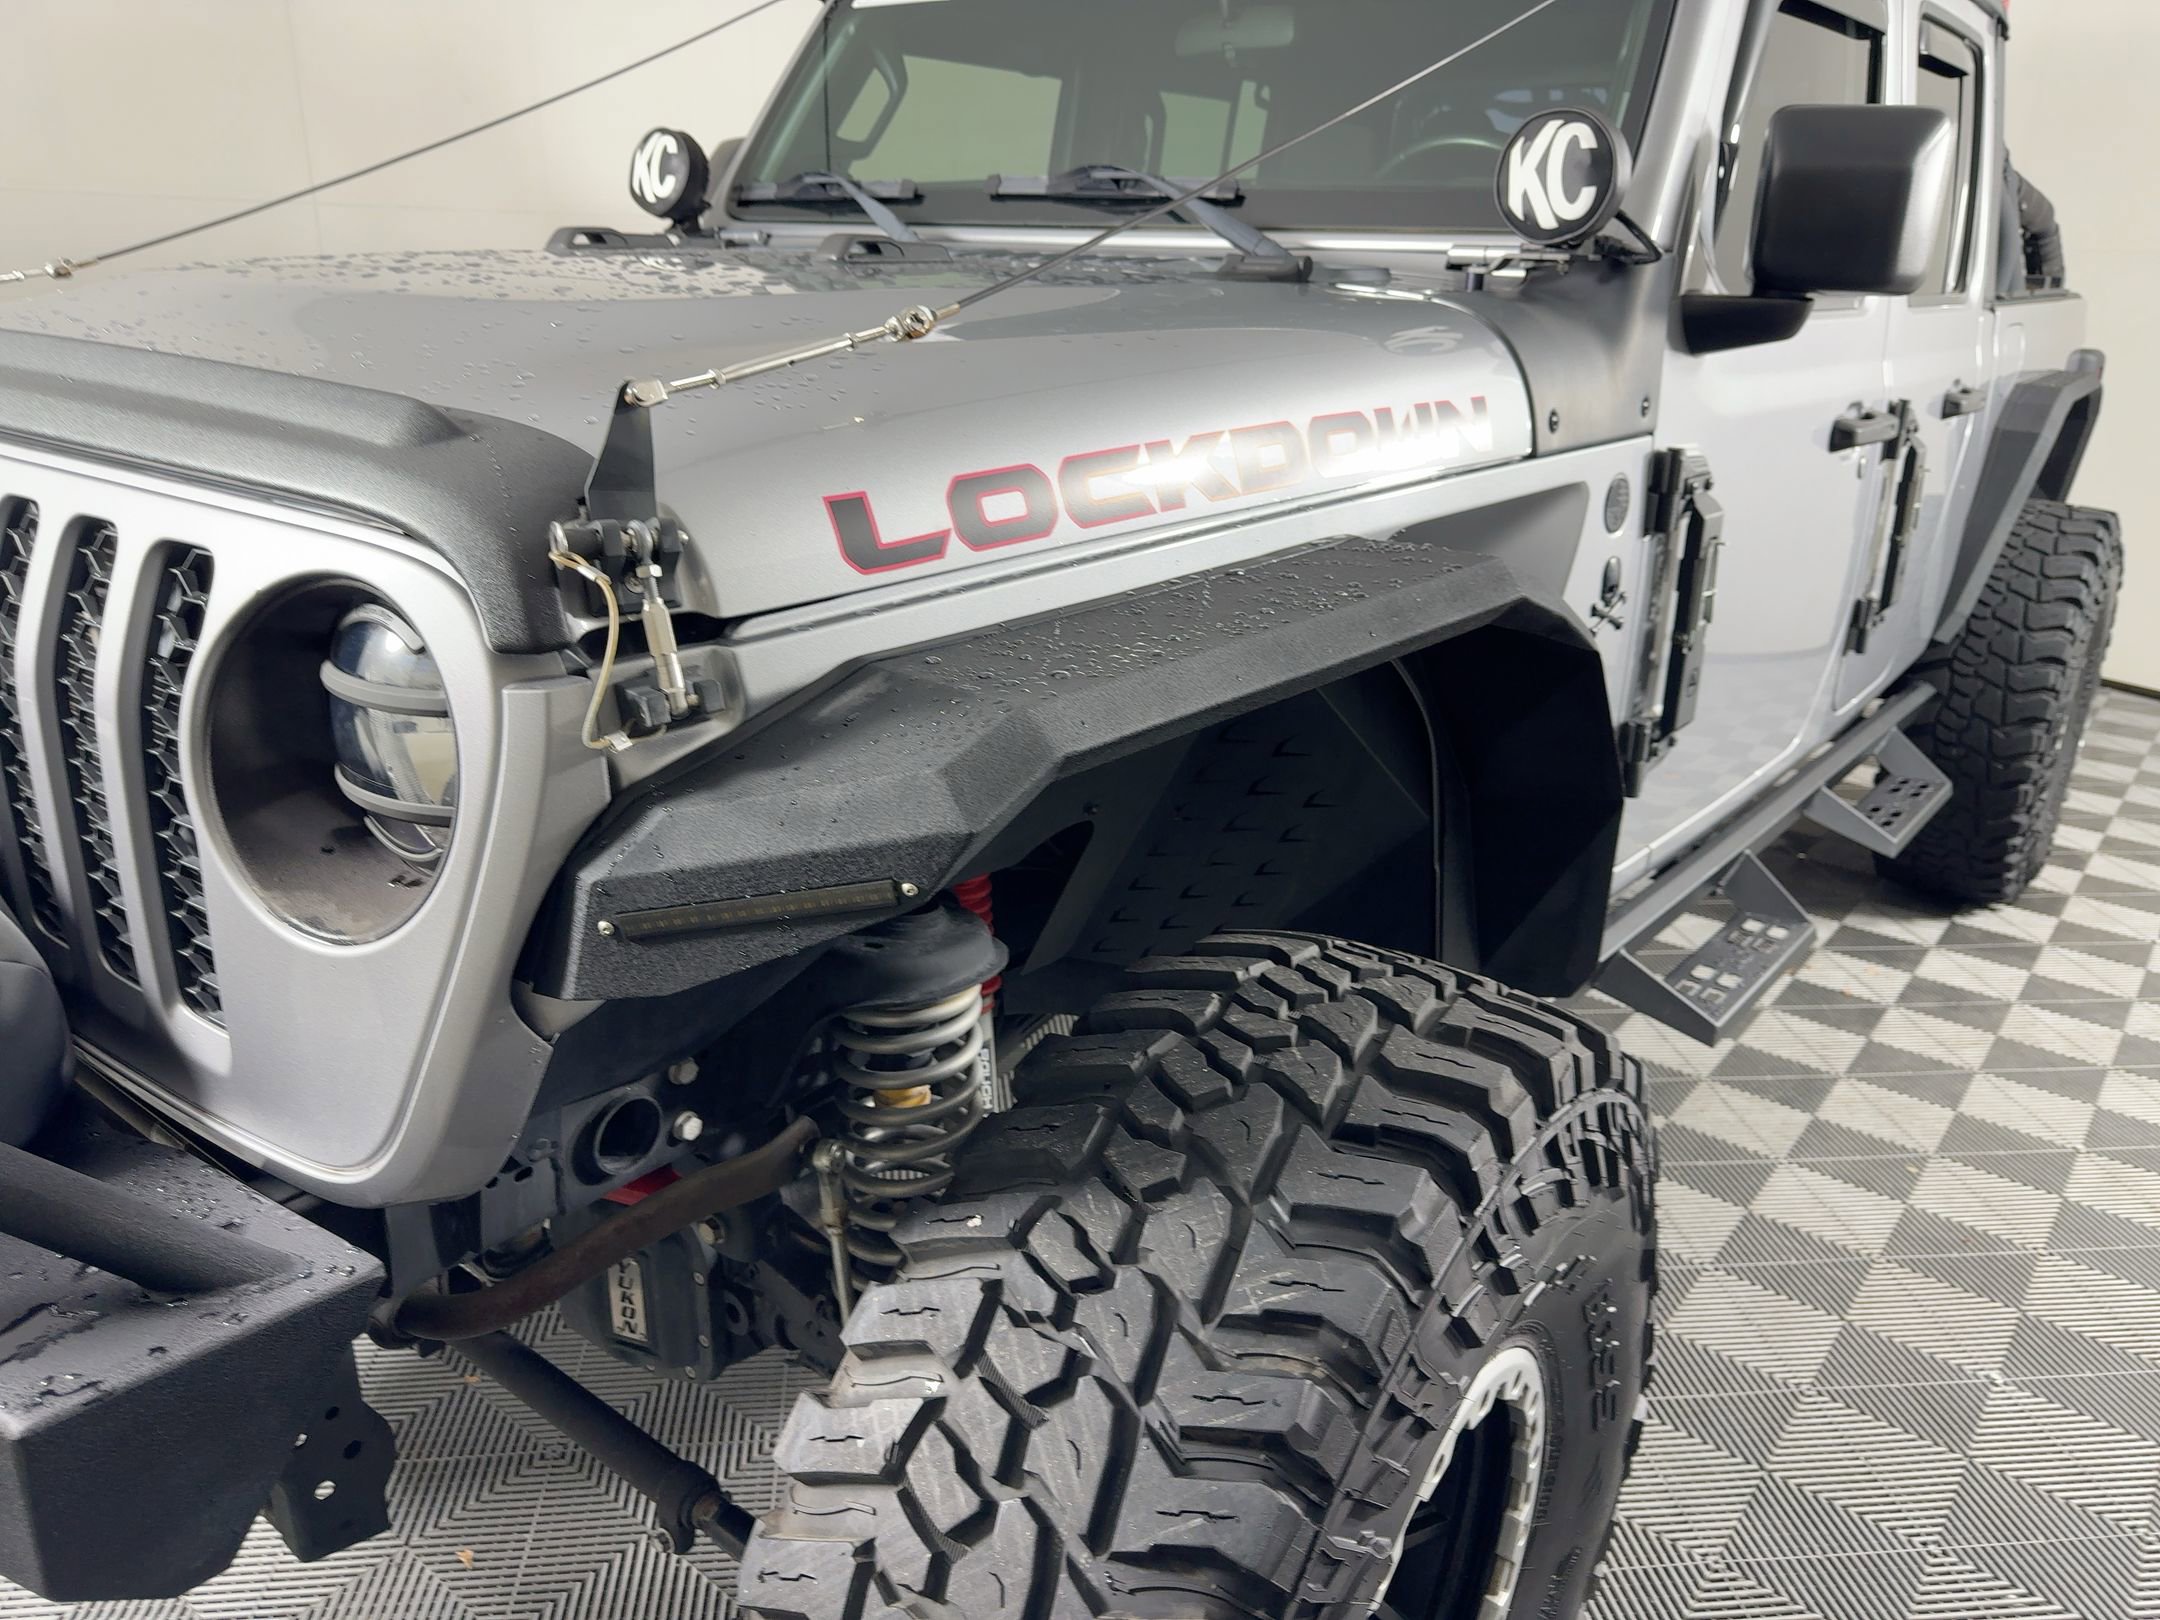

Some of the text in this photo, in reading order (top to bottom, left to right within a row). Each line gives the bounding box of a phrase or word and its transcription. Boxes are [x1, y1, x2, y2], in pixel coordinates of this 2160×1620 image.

[632, 132, 678, 203] KC
[1508, 119, 1598, 230] KC
[822, 395, 1494, 575] LOCKDOWN
